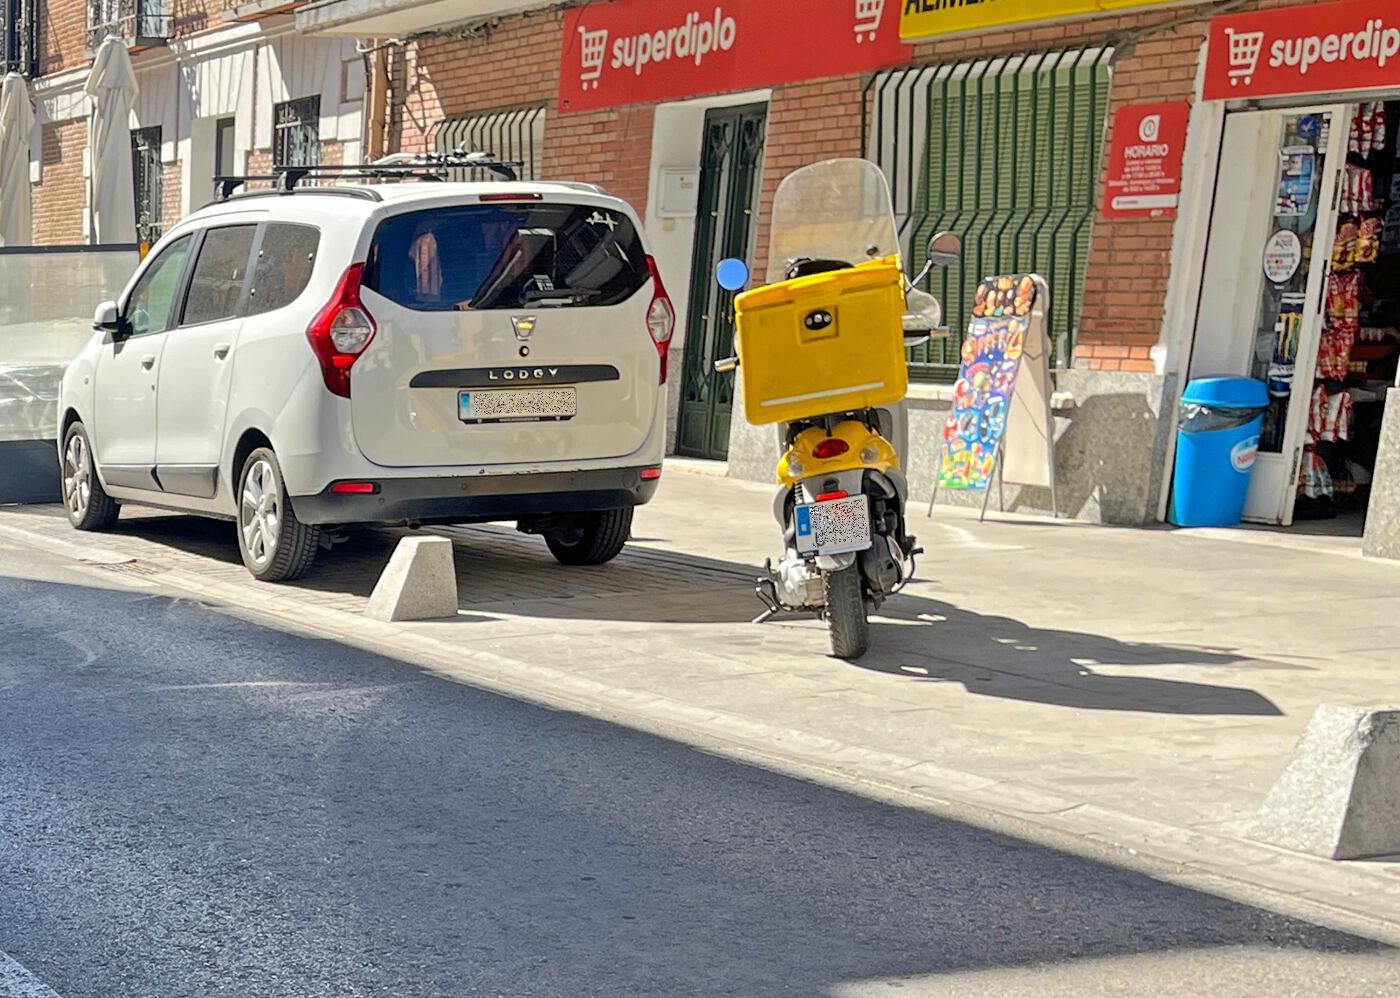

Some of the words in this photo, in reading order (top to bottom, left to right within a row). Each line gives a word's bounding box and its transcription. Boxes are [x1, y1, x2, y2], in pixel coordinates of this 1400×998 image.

[611, 7, 736, 76] superdiplo
[1124, 144, 1169, 159] HORARIO
[489, 368, 558, 381] LODGY
